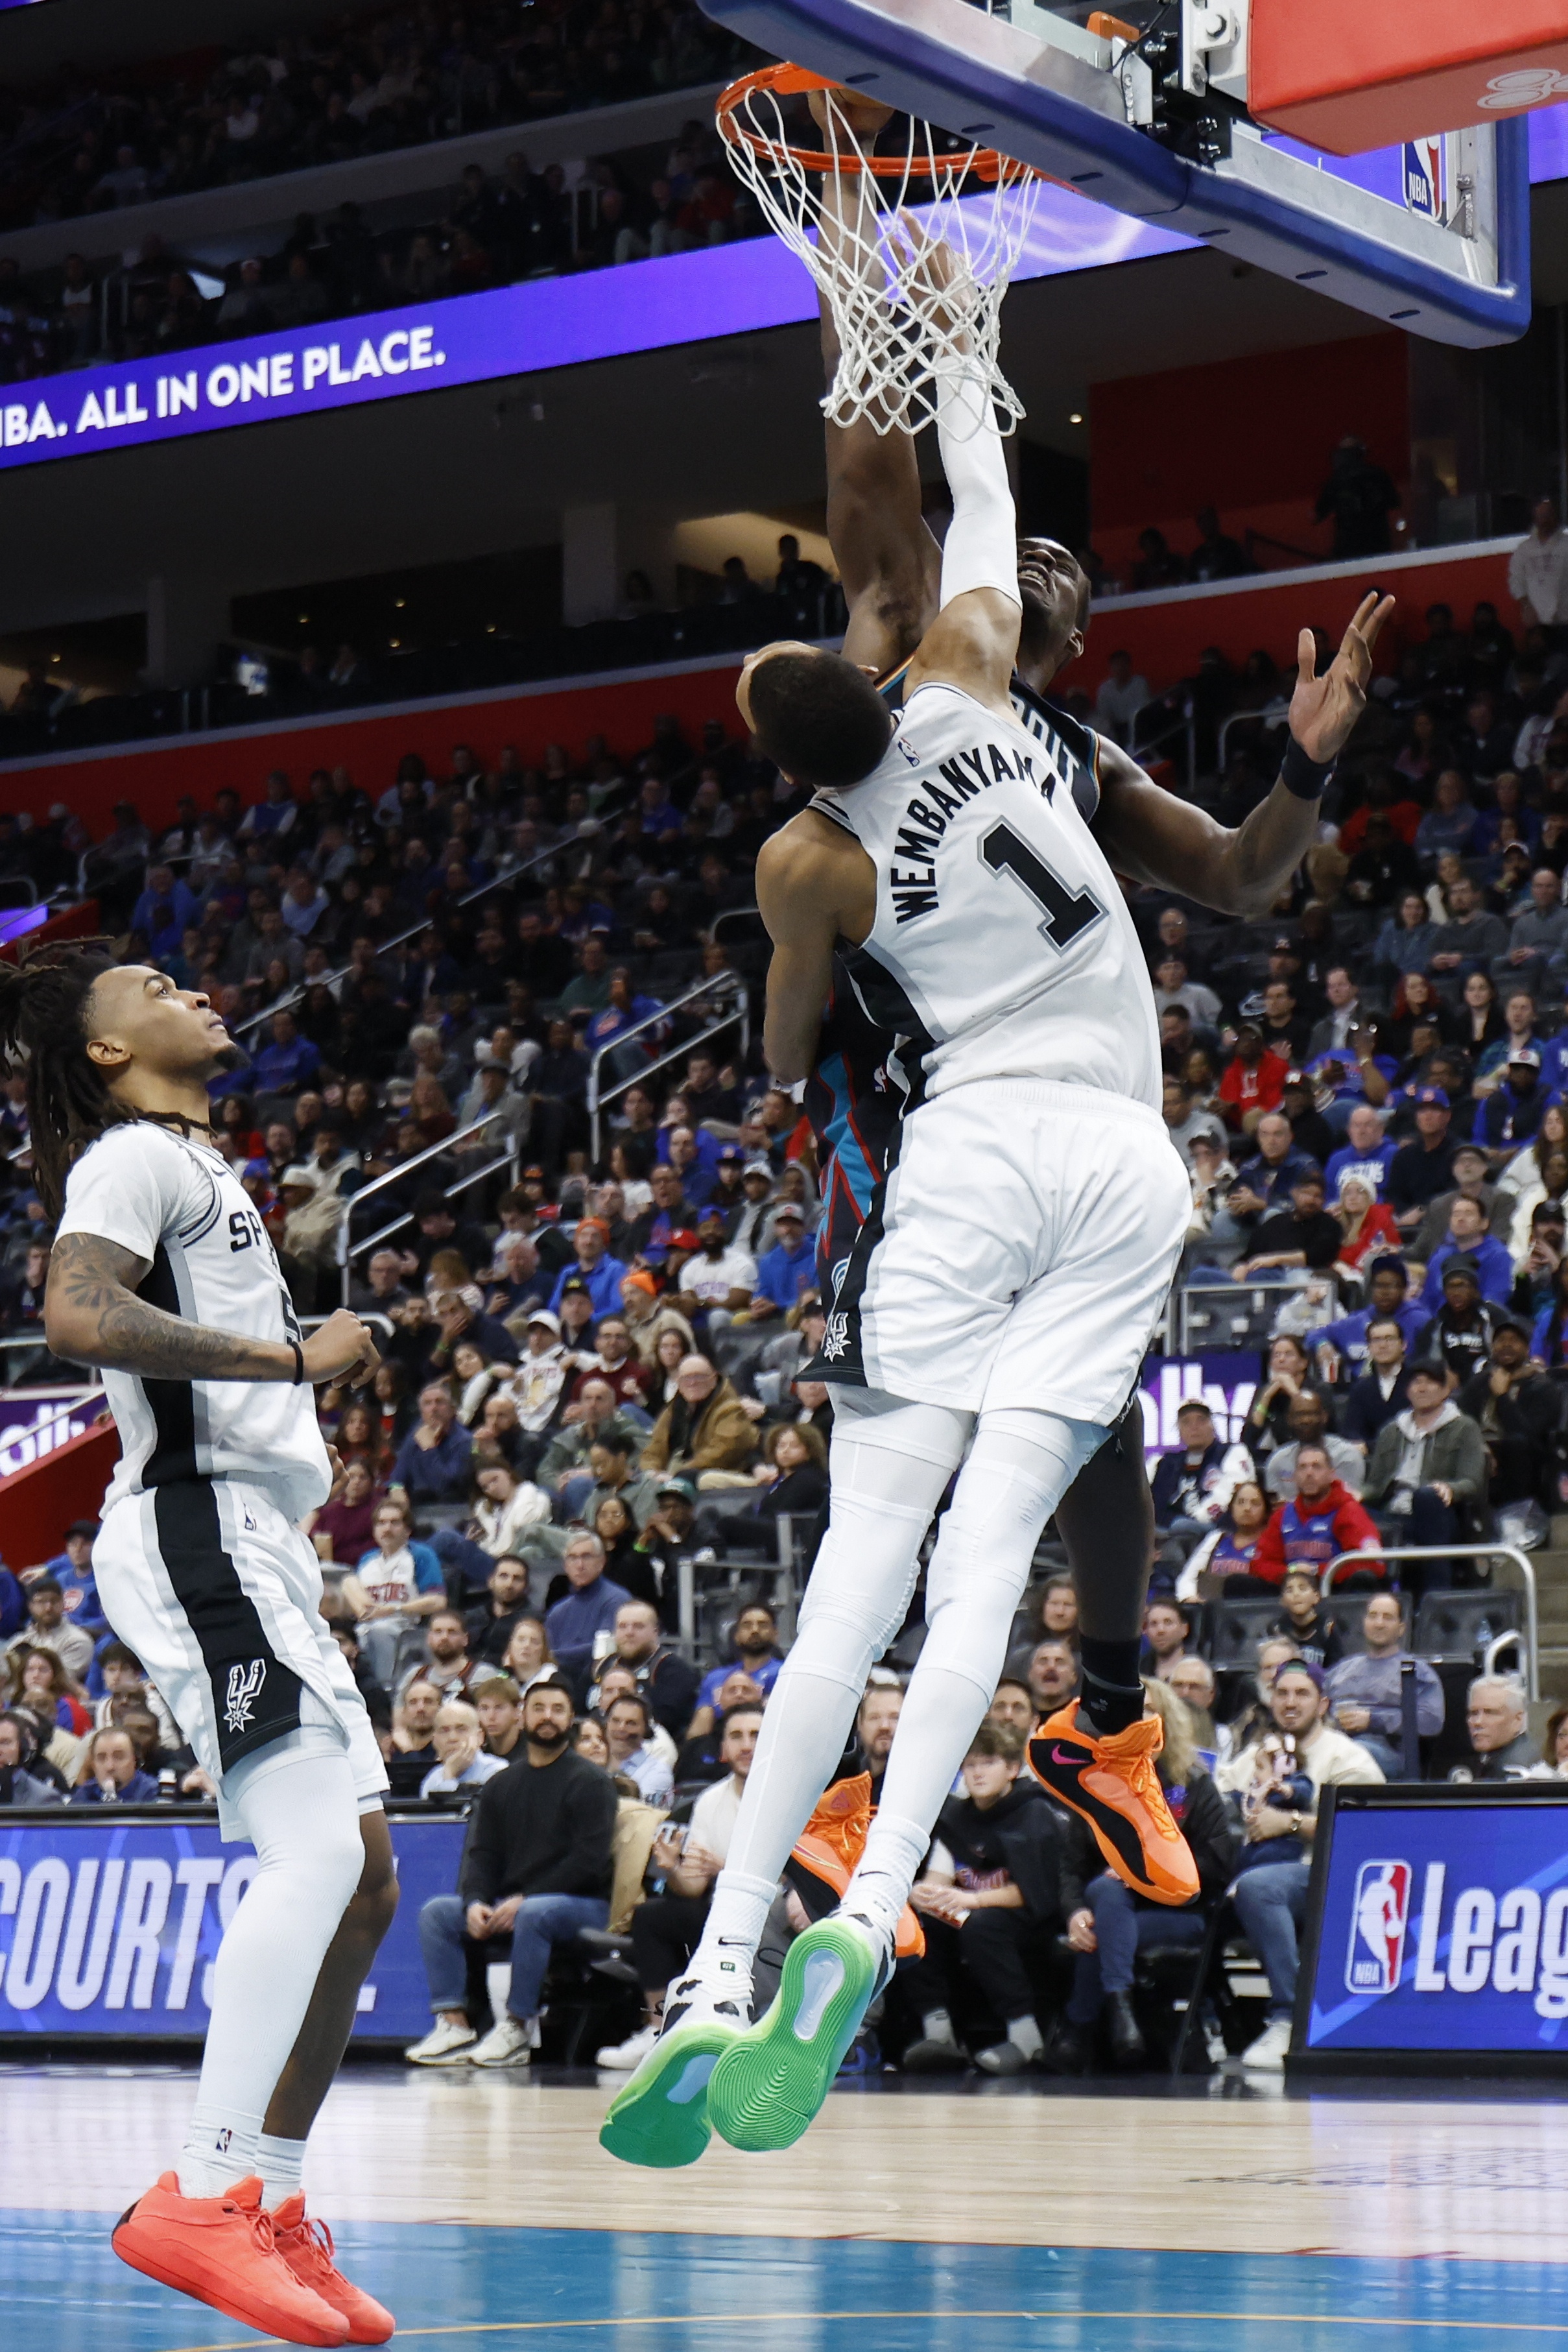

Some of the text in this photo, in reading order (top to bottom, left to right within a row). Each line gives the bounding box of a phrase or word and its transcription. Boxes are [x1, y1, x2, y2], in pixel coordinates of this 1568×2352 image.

[1408, 171, 1428, 206] NBA
[0, 324, 447, 449] BA. ALL IN ONE PLACE.
[890, 743, 1056, 925] WEMBANYAMA
[977, 814, 1110, 957] 1
[1354, 1960, 1381, 1986] NBA
[1414, 1860, 1568, 2020] Leag
